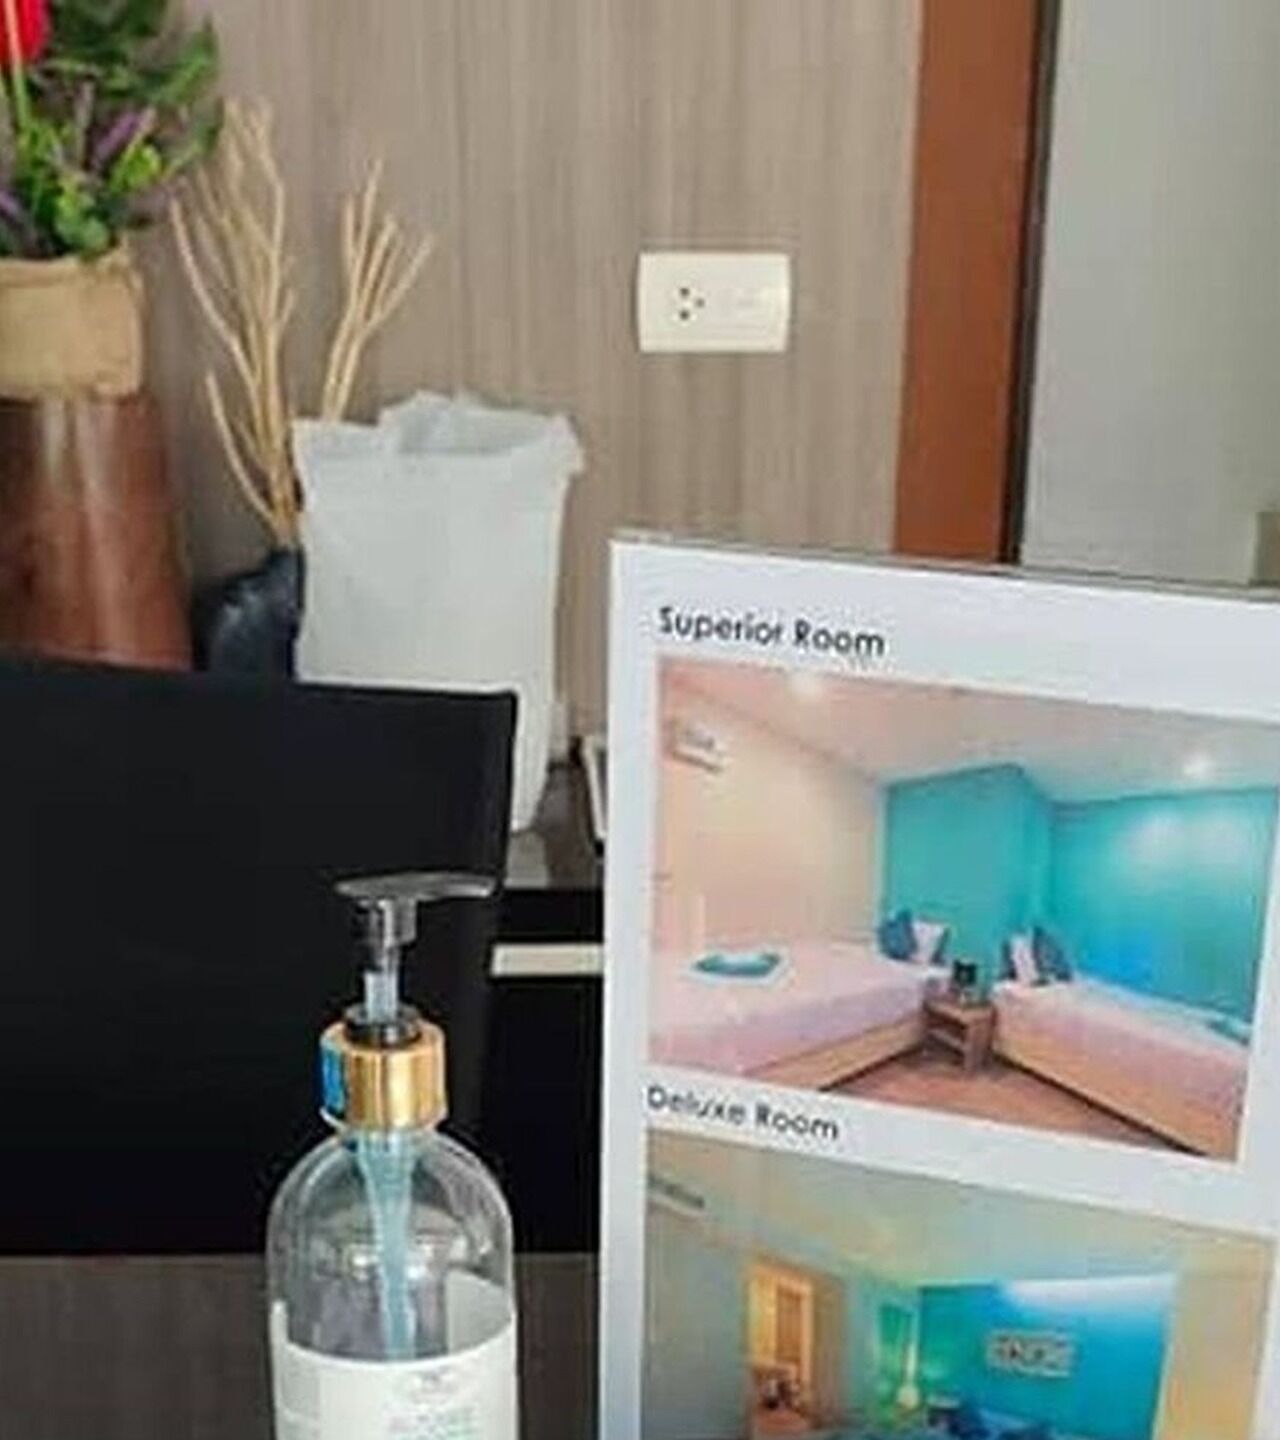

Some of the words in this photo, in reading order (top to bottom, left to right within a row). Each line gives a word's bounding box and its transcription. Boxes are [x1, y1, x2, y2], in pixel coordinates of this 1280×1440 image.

[658, 605, 783, 645] Superior
[793, 618, 886, 656] Room
[647, 1084, 746, 1125] Deluxe
[755, 1102, 839, 1141] Room
